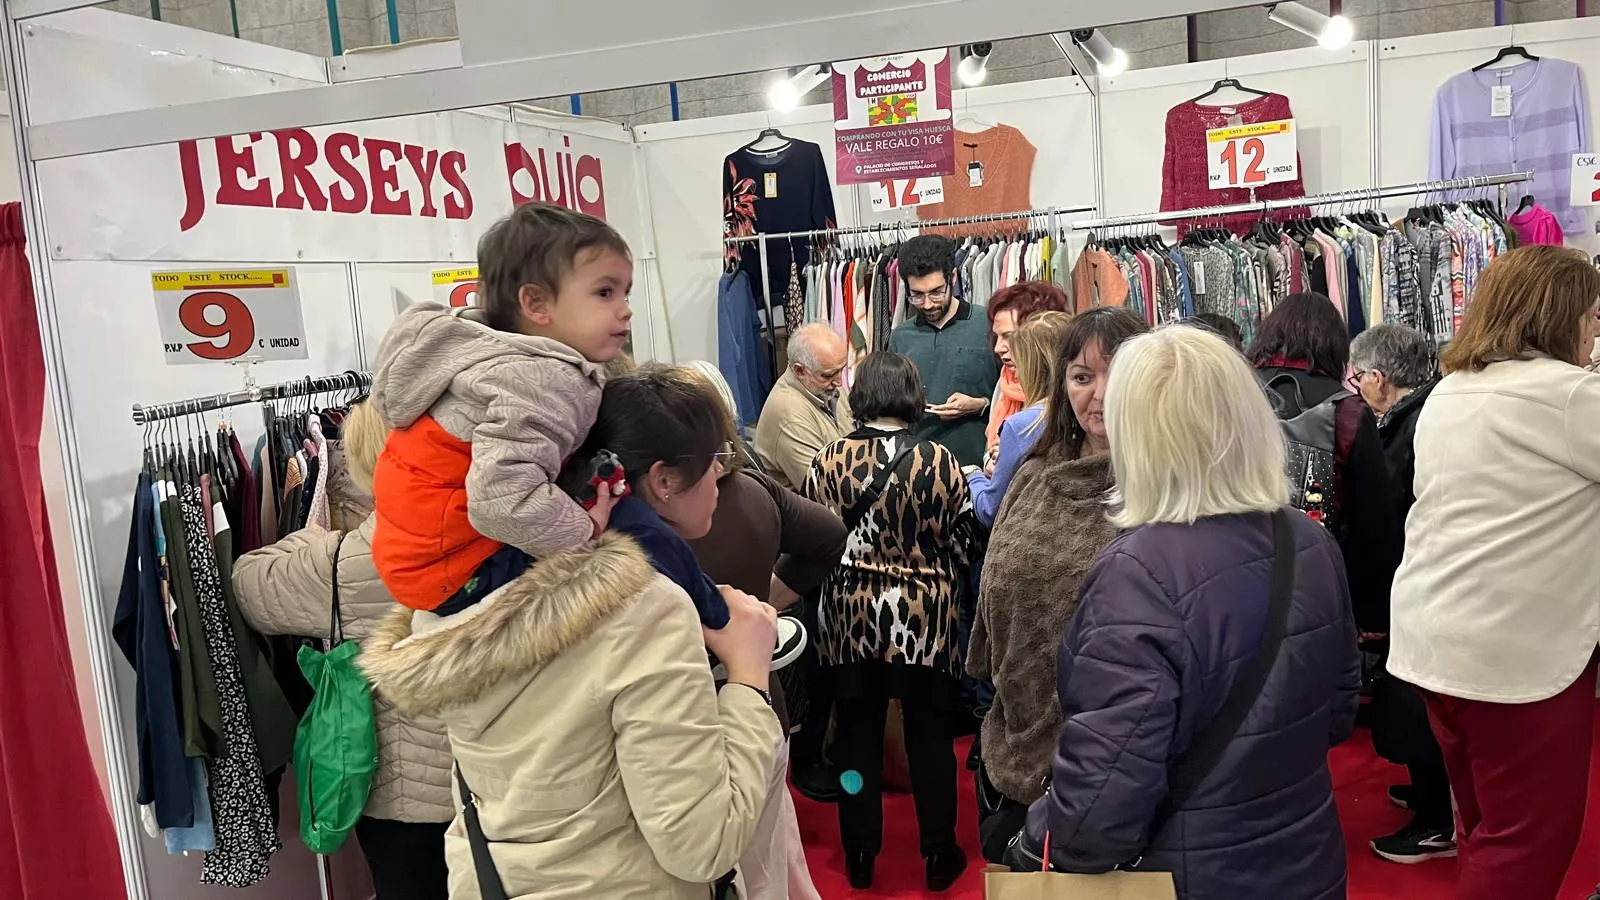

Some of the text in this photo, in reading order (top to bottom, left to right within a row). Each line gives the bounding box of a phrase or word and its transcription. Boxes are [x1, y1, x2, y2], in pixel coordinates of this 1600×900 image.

[867, 69, 911, 82] COMERCIO
[860, 80, 924, 96] PARTICIPANTE
[837, 132, 881, 143] COMPRANDO
[925, 125, 952, 134] HUESCA
[845, 134, 944, 154] VALE REGALO 10€
[863, 163, 937, 174] ESTABLECIMIENTOS SEÑALADOS
[1220, 137, 1266, 185] 12
[1273, 165, 1293, 173] UNIDAD
[178, 127, 474, 232] JERSEYS
[880, 176, 921, 208] 12
[152, 274, 179, 282] TODO
[189, 273, 213, 281] ESTE
[164, 343, 183, 353] P.V.P
[178, 291, 256, 361] 9
[269, 337, 300, 348] UNIDAD
